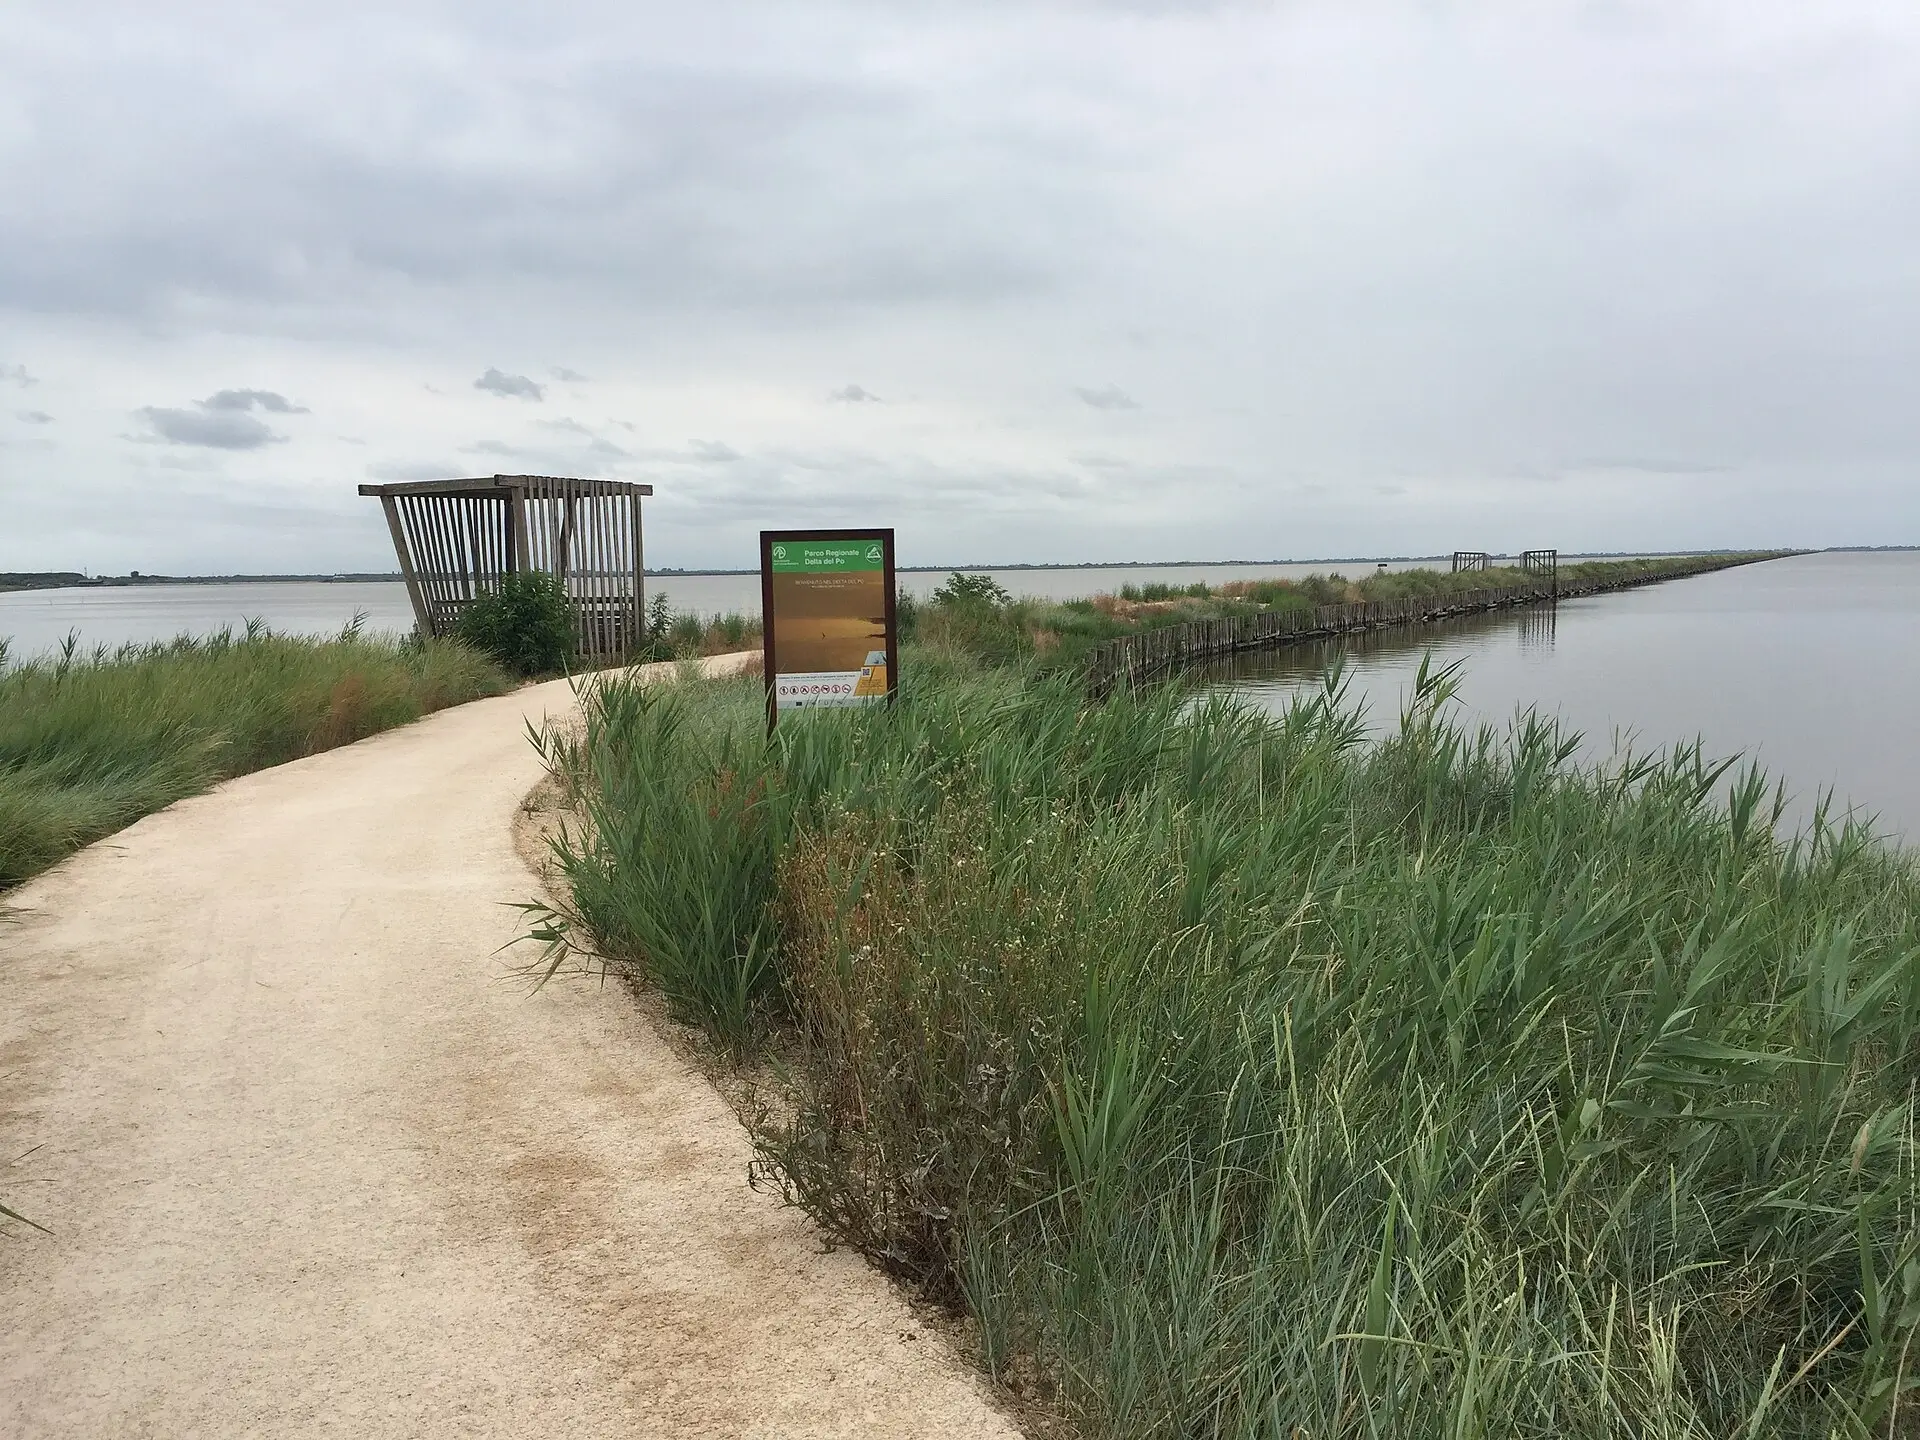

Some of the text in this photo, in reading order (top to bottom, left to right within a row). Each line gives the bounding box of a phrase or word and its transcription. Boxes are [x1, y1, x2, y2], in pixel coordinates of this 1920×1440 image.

[804, 549, 860, 558] Parco Regionale
[835, 557, 845, 565] Po
